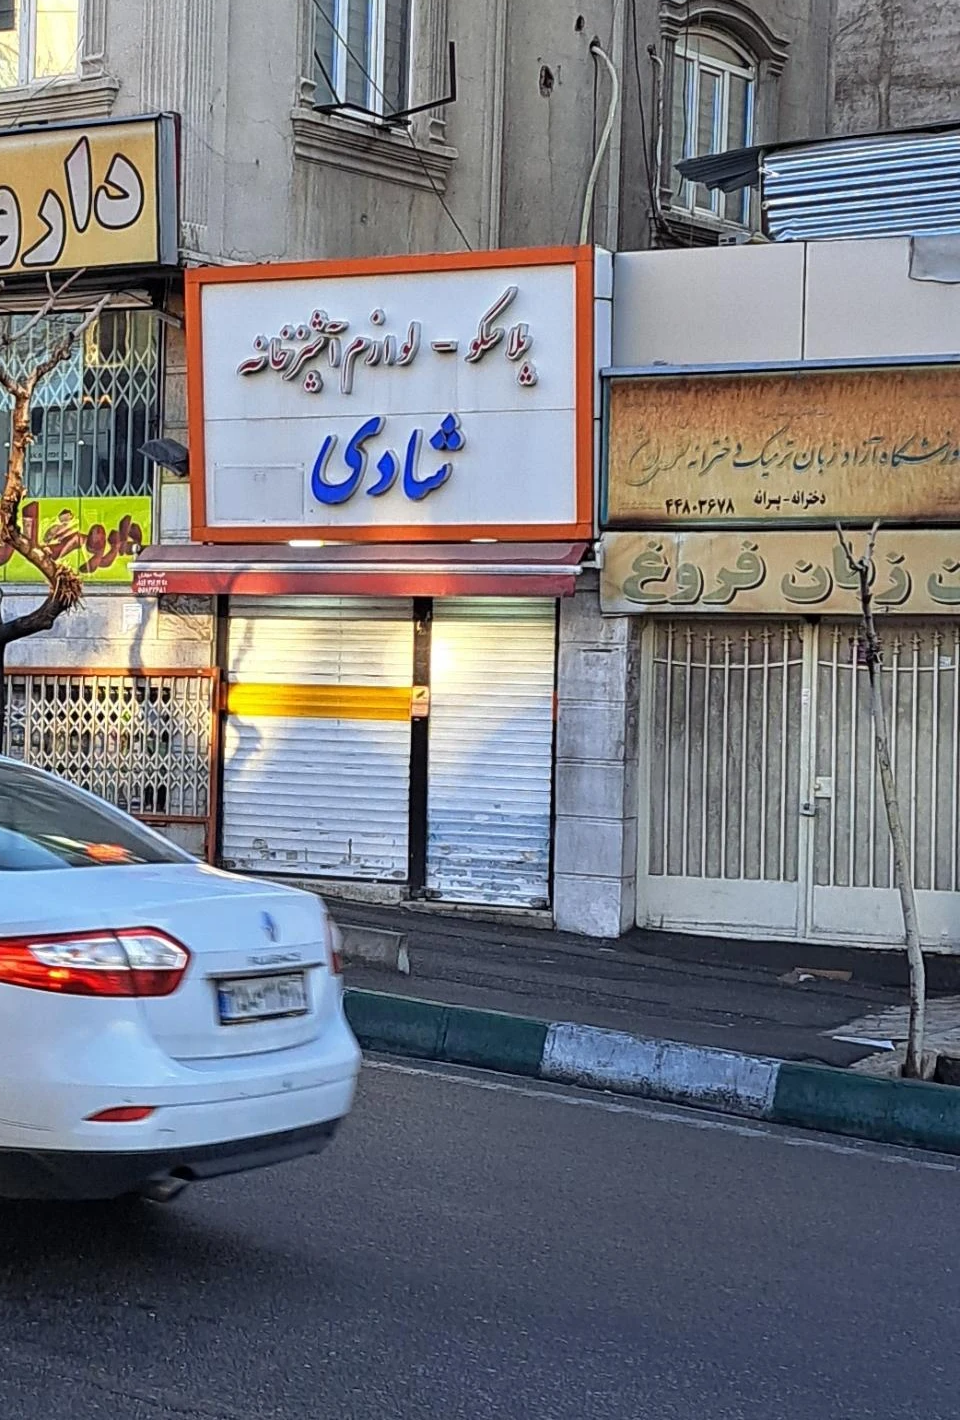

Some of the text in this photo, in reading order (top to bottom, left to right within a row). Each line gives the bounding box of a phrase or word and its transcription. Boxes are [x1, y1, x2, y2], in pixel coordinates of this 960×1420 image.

[237, 308, 349, 394] آشپزخانه
[340, 308, 422, 394] لوازم
[465, 284, 539, 387] پلاسکو
[310, 412, 466, 505] شادی
[664, 497, 735, 515] ۴۴۸۰۳۶۷۸
[621, 539, 768, 608] فروغ
